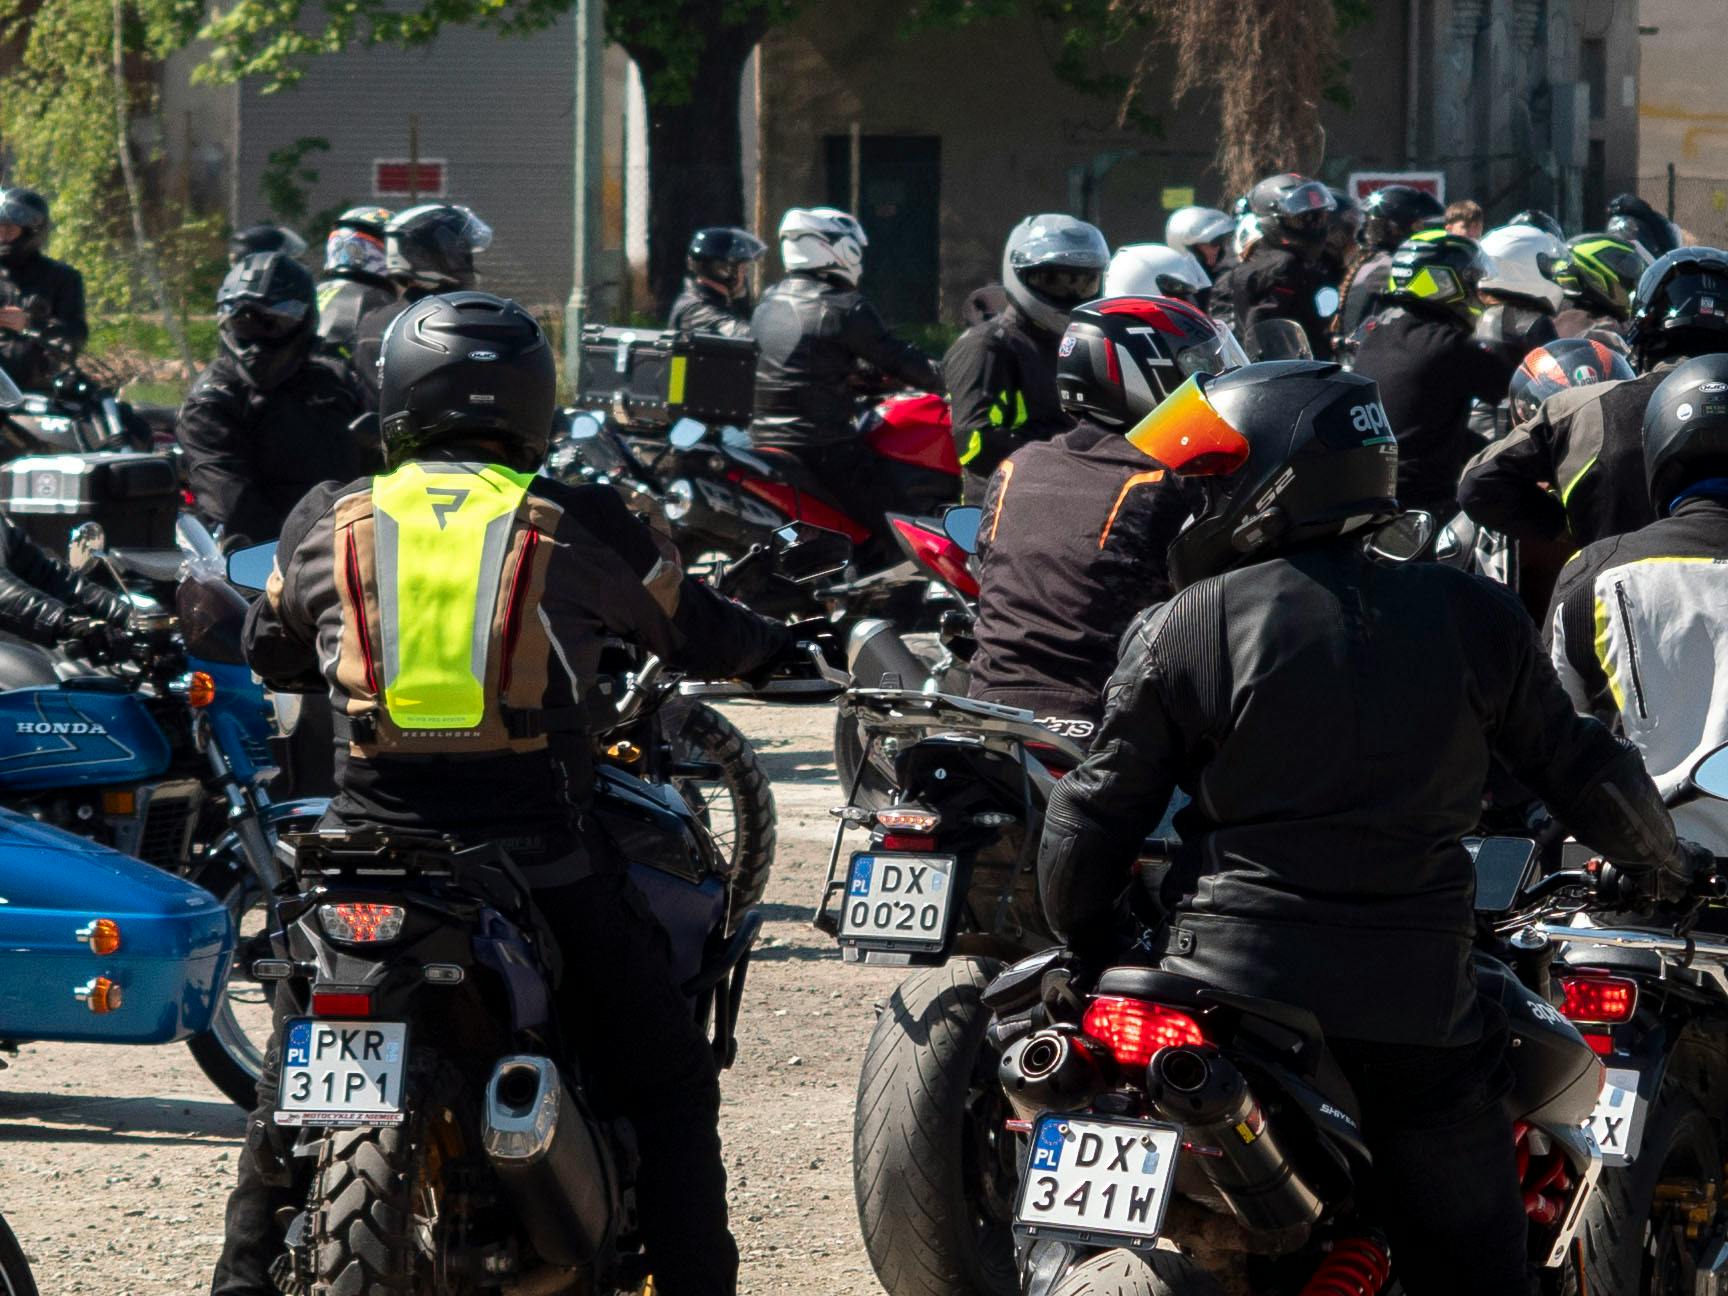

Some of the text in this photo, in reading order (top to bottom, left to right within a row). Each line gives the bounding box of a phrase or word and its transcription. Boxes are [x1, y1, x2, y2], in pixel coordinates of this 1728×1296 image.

[16, 722, 107, 734] HONDA
[851, 879, 868, 892] PL
[880, 865, 928, 894] DX
[850, 901, 939, 931] 0020
[287, 1048, 308, 1063] PL
[315, 1029, 385, 1061] PKR
[290, 1071, 388, 1103] 31P1
[1033, 1148, 1058, 1167] PL
[1075, 1132, 1137, 1172] DX
[1032, 1176, 1156, 1223] 341W
